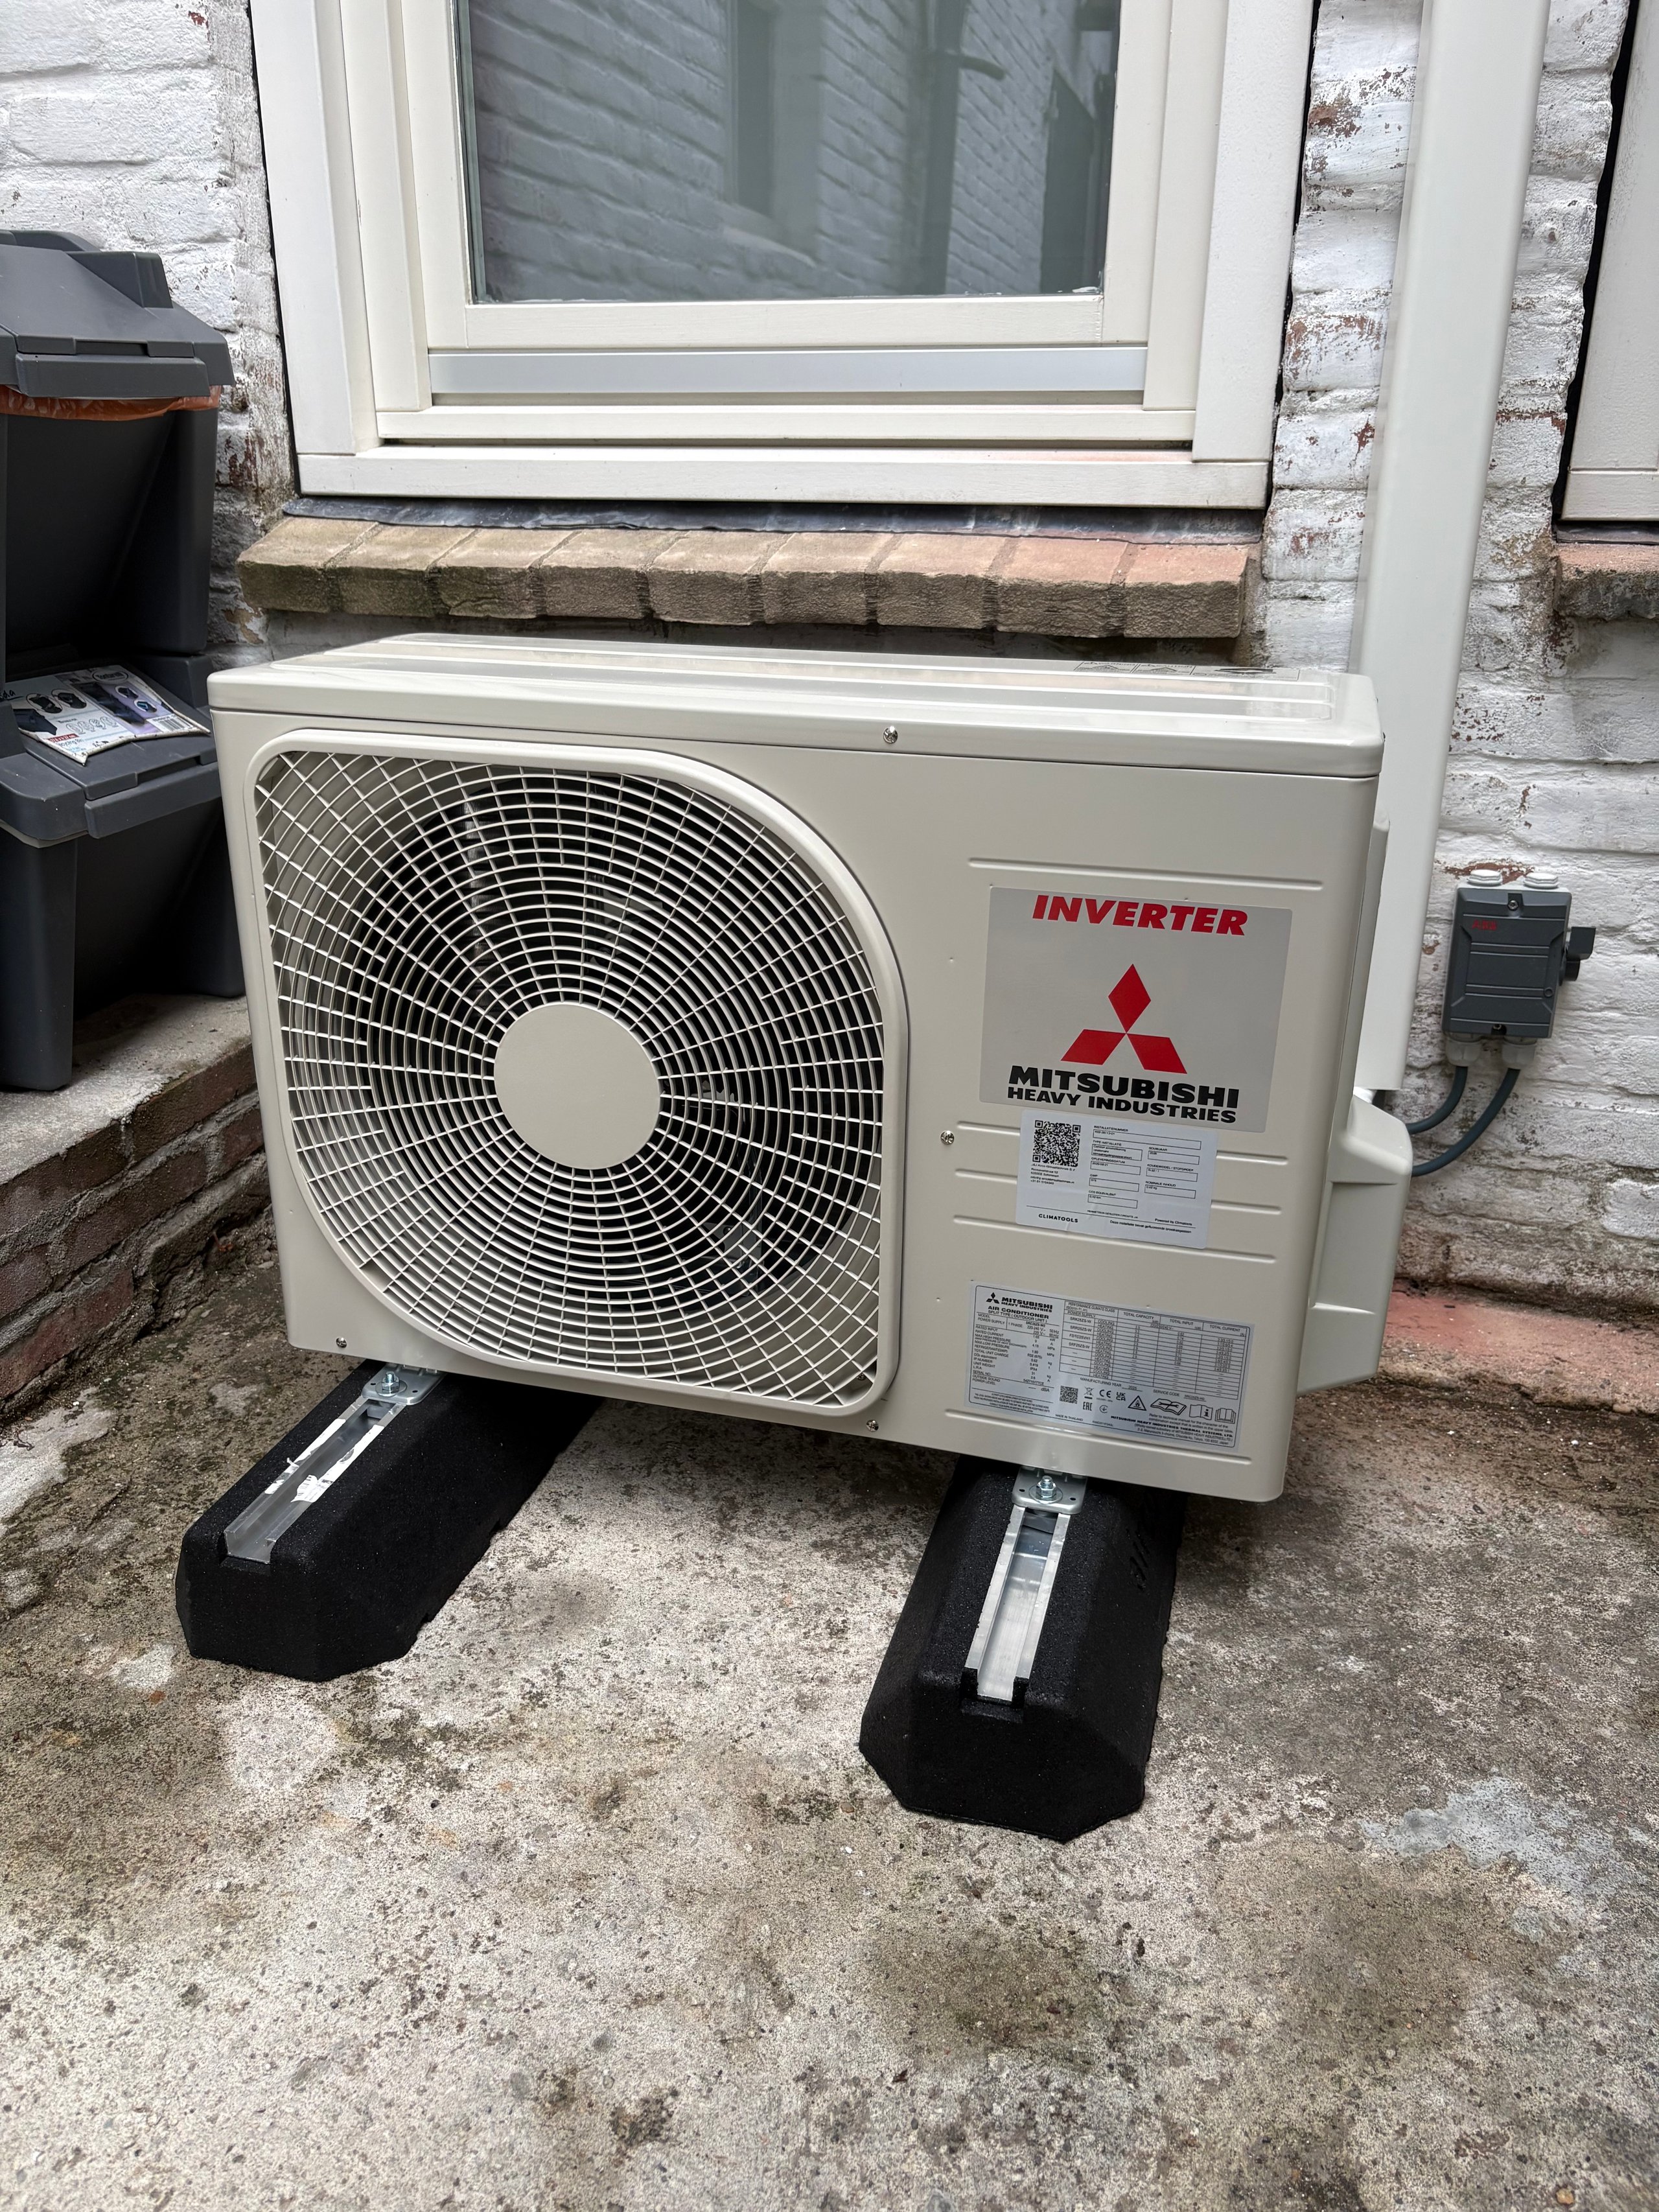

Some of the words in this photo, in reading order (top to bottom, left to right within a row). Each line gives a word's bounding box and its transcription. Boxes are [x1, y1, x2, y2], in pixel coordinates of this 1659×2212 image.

[1032, 894, 1248, 936] INVERTER
[1008, 1065, 1240, 1109] MITSUBISHI
[1008, 1087, 1082, 1106] HEAVY
[1088, 1096, 1236, 1124] INDUSTRIES
[1039, 1214, 1078, 1223] CLIMATOOLS
[1001, 1296, 1052, 1309] MITSUBISHI
[1001, 1307, 1049, 1319] CONDITIONER
[1080, 1377, 1111, 1385] MANUFACTURING
